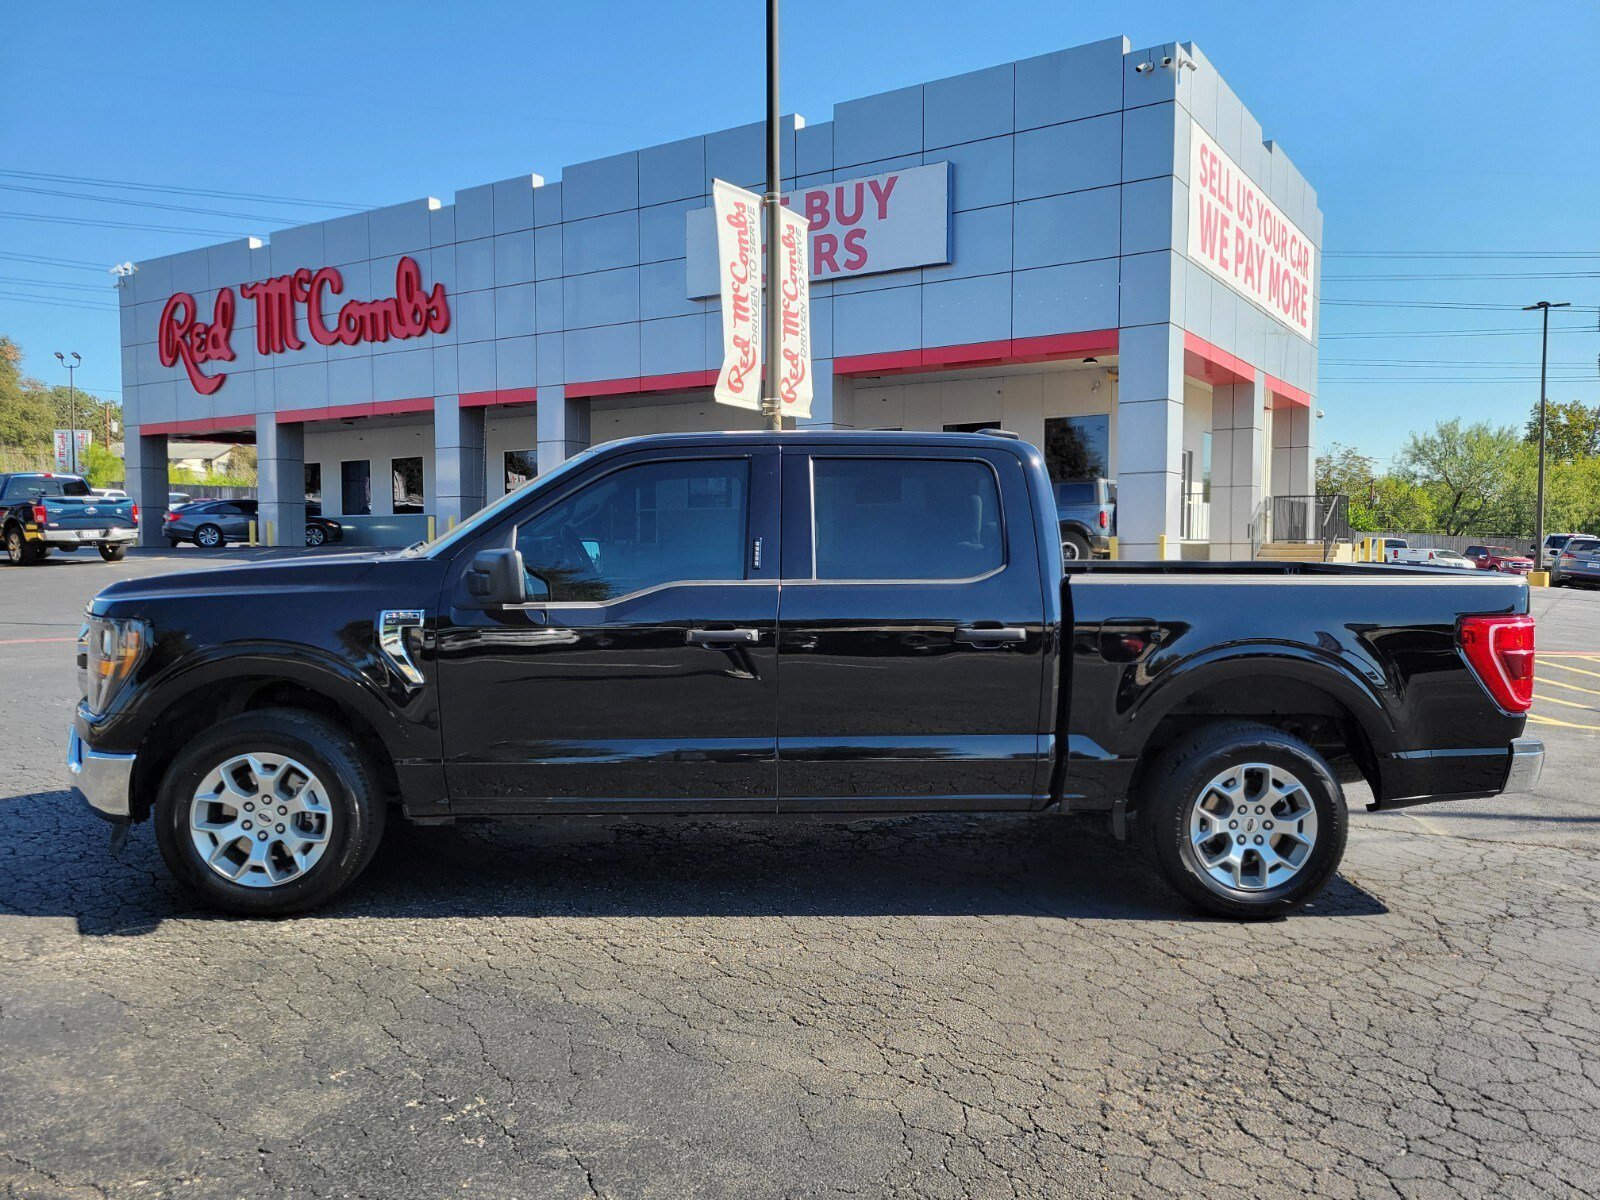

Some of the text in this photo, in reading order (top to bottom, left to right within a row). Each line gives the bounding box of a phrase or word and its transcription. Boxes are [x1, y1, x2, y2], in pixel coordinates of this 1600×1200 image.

[805, 175, 898, 231] BUY
[1199, 142, 1309, 281] SELL US YOUR CAR
[1199, 193, 1307, 329] WE PAY MORE
[158, 256, 450, 395] Red McCombs
[727, 201, 757, 393] Red McCombs
[747, 205, 758, 346] DRIVEN TO SERVE
[780, 223, 805, 403] Red McCombs
[796, 227, 807, 358] DRIVEN TO SERVE
